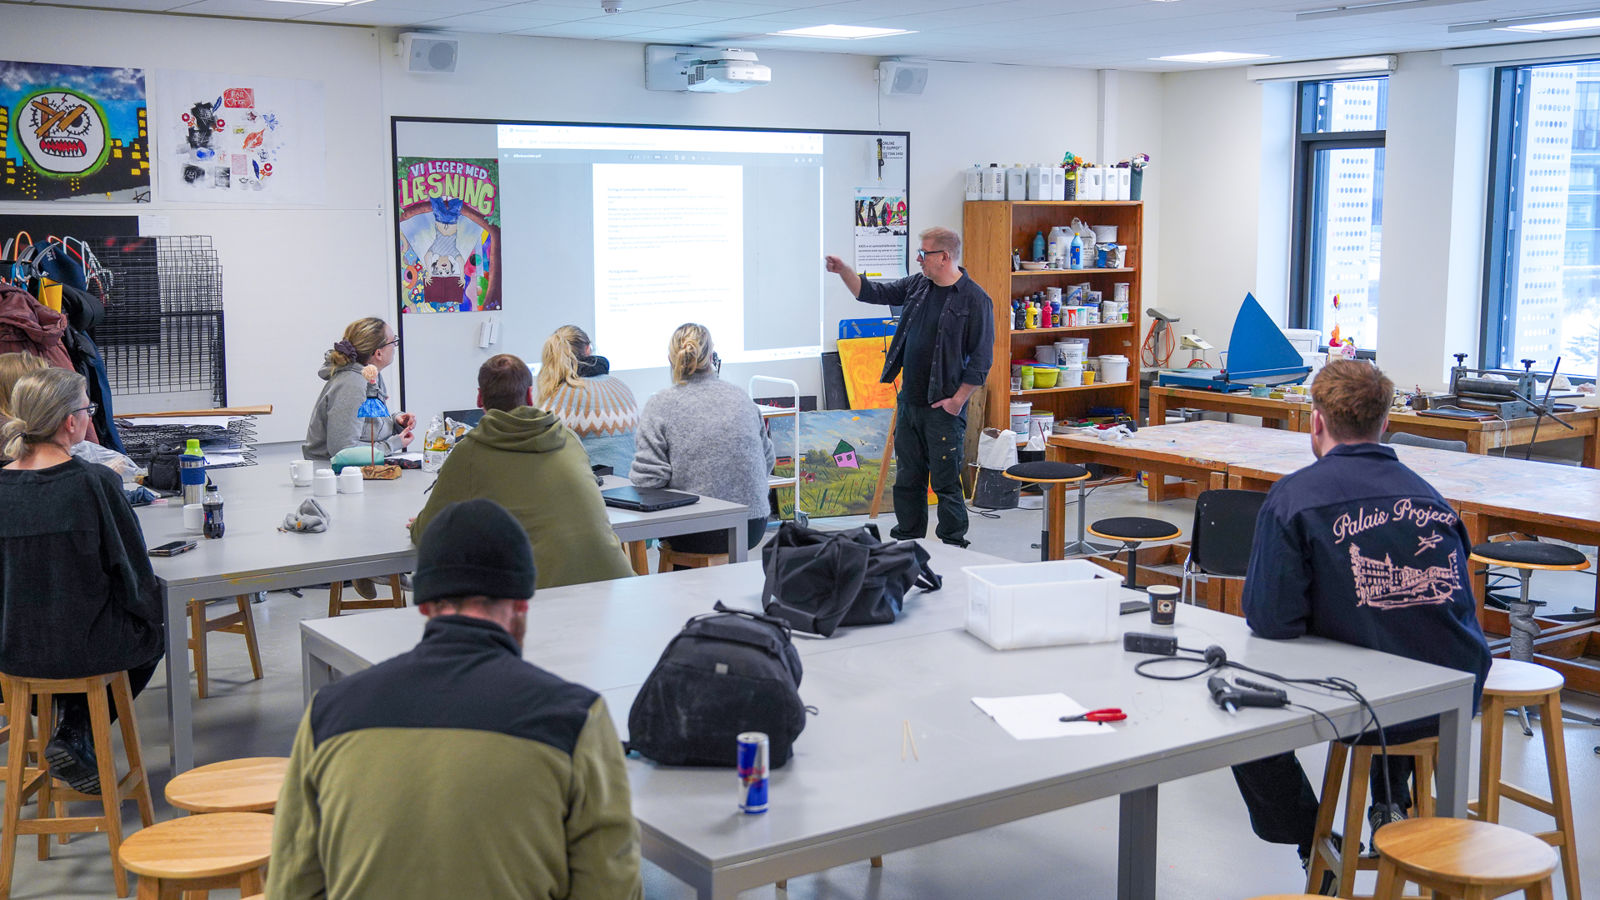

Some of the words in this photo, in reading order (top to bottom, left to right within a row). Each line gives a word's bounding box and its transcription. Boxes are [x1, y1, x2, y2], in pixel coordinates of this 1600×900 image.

[410, 163, 425, 177] VI
[428, 161, 464, 174] LEGER
[465, 164, 488, 180] MED
[402, 173, 495, 215] LÆSNING
[1333, 507, 1389, 545] Palais
